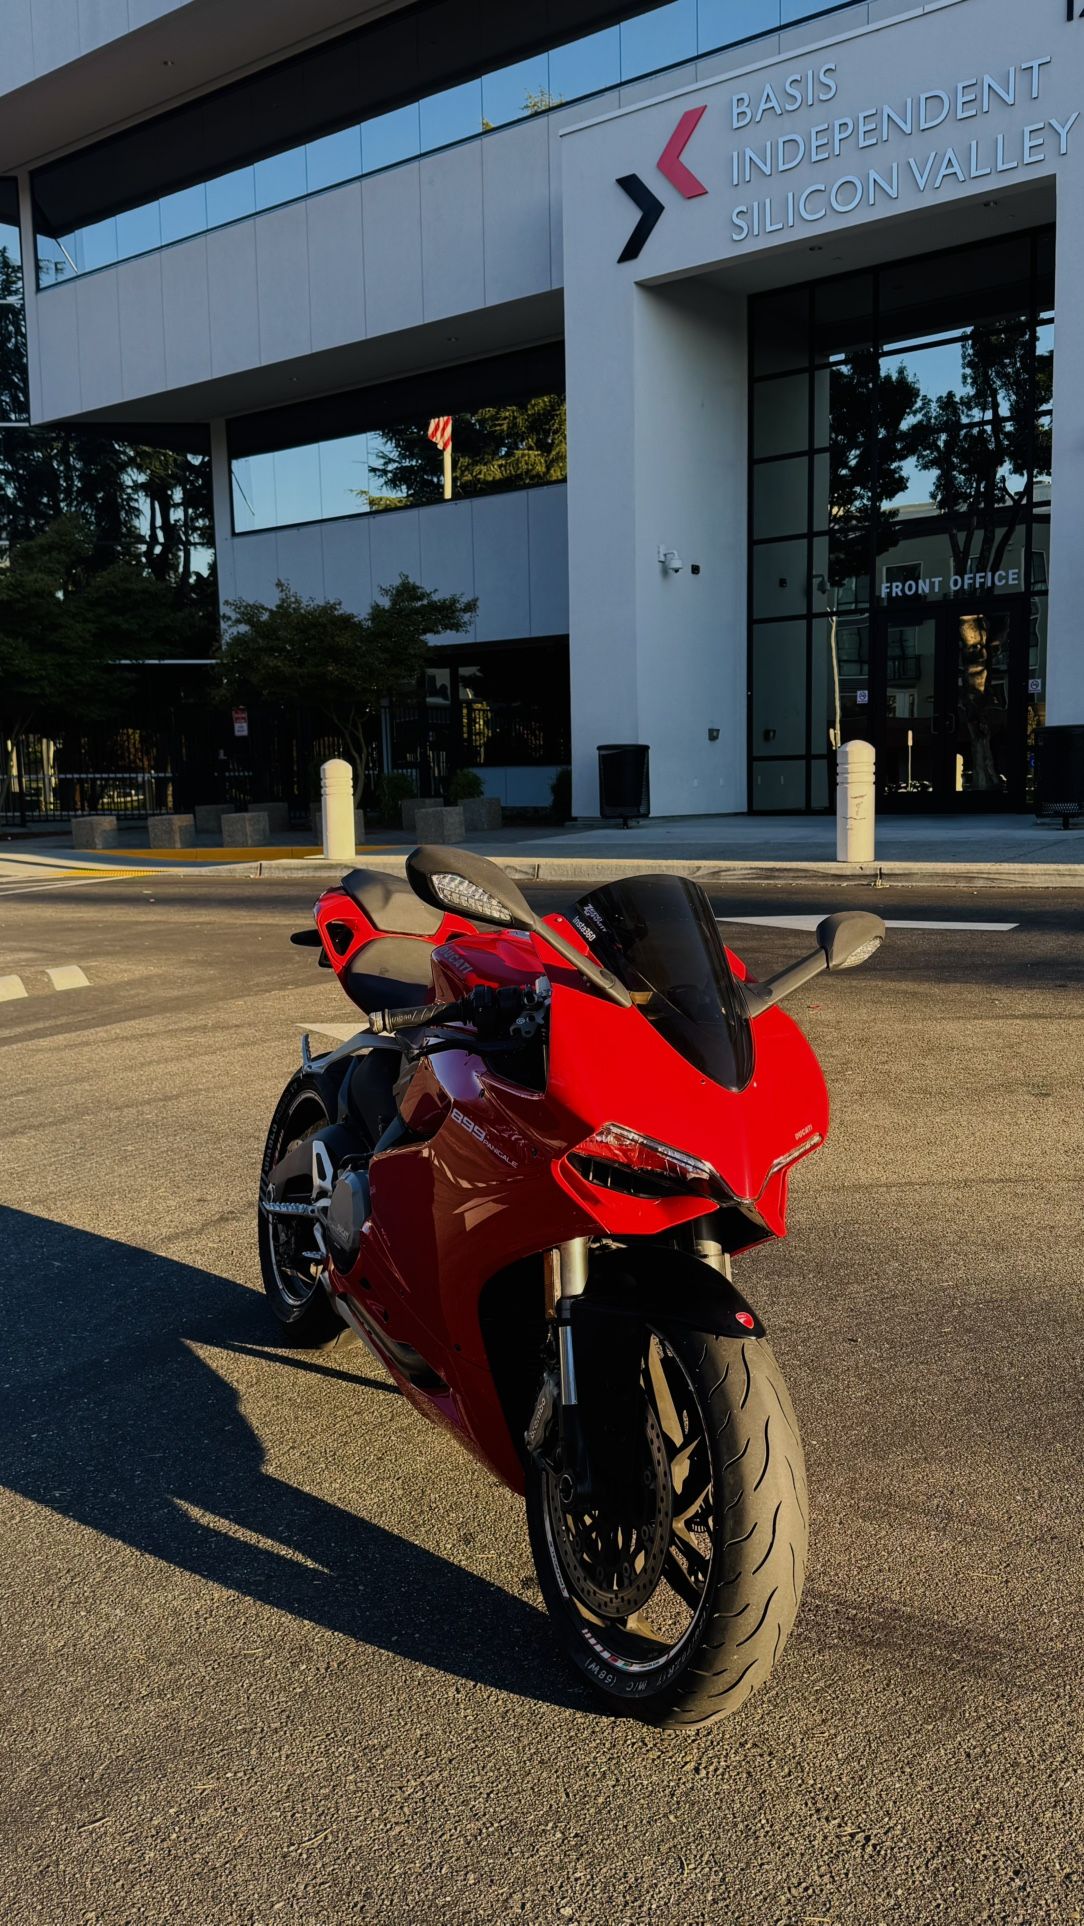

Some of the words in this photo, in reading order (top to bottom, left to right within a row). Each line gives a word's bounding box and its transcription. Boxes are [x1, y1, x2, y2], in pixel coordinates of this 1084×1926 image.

[732, 63, 838, 130] BASIS
[732, 55, 1051, 186] INDEPENDENT
[731, 162, 899, 242] SILICON
[908, 112, 1081, 192] VALLEY
[880, 577, 943, 598] FRONT
[949, 569, 1019, 591] OFFICE
[572, 915, 597, 942] Insta360
[440, 946, 474, 974] DUCATI
[451, 1108, 486, 1143] 899
[482, 1138, 519, 1169] PANIGALE
